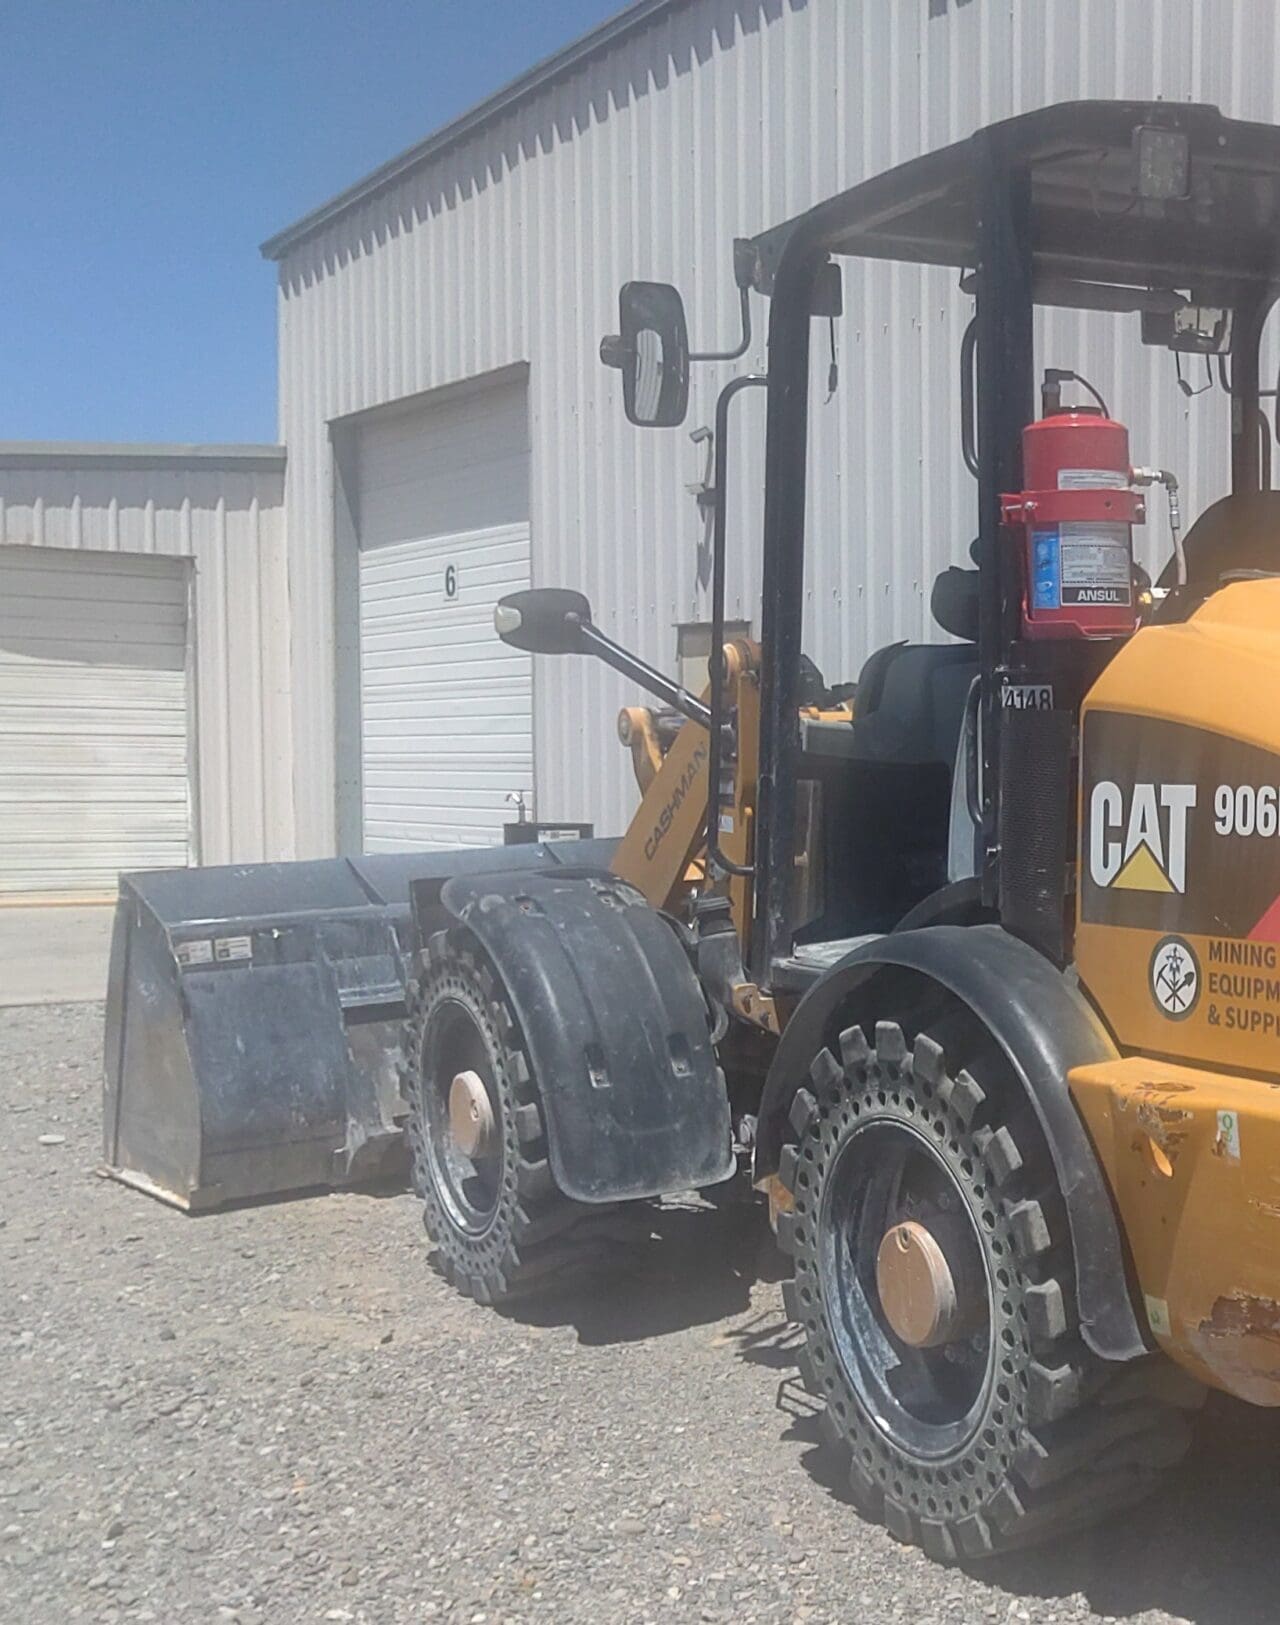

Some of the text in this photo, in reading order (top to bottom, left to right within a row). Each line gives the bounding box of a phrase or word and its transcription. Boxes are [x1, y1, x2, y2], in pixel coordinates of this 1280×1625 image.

[444, 565, 456, 597] 6
[1077, 590, 1120, 602] ANSUL
[644, 742, 707, 861] CASHMAN
[1090, 781, 1197, 894] CAT
[1208, 940, 1277, 970] MINING
[1207, 1003, 1220, 1026] &
